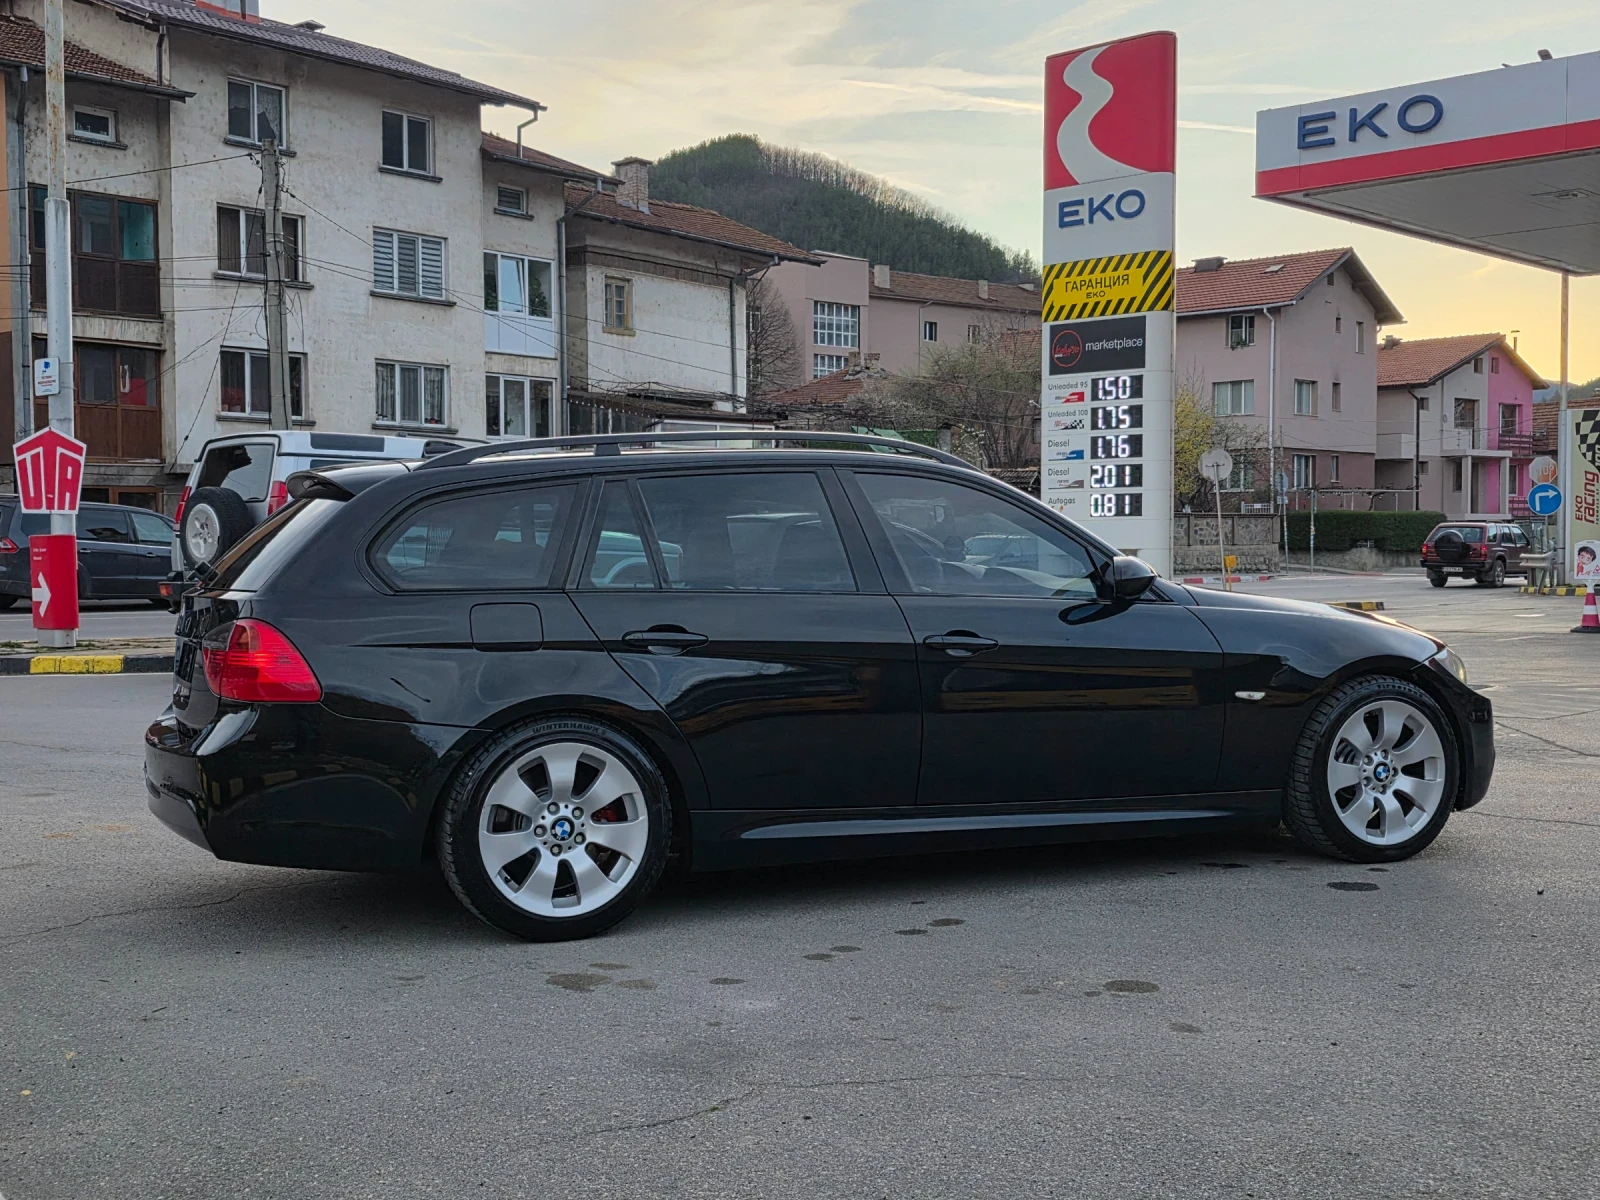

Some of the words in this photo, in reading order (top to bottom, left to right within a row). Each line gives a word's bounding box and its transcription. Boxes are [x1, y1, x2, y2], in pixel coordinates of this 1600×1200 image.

[1297, 94, 1443, 150] EKO
[1058, 189, 1146, 228] EKO
[1065, 273, 1130, 294] ГАРАНЦИЯ
[1085, 290, 1106, 299] EKO
[1085, 337, 1143, 352] marketplace
[1047, 381, 1079, 391] Unleaded
[1079, 380, 1089, 389] 95
[1098, 375, 1131, 400] 1.50
[1047, 409, 1077, 419] Unleaded
[1077, 409, 1089, 417] 100
[1098, 405, 1130, 430] 1.75
[1047, 438, 1070, 448] Diesel
[1098, 435, 1130, 459] 1.76
[1047, 467, 1070, 476] Diesel
[1091, 464, 1131, 488] 2.01
[1047, 497, 1076, 506] Autogas
[1090, 493, 1131, 517] 0.81
[1575, 495, 1583, 521] EKO
[1584, 470, 1600, 525] racing
[532, 721, 599, 735] WINTERHAWK
